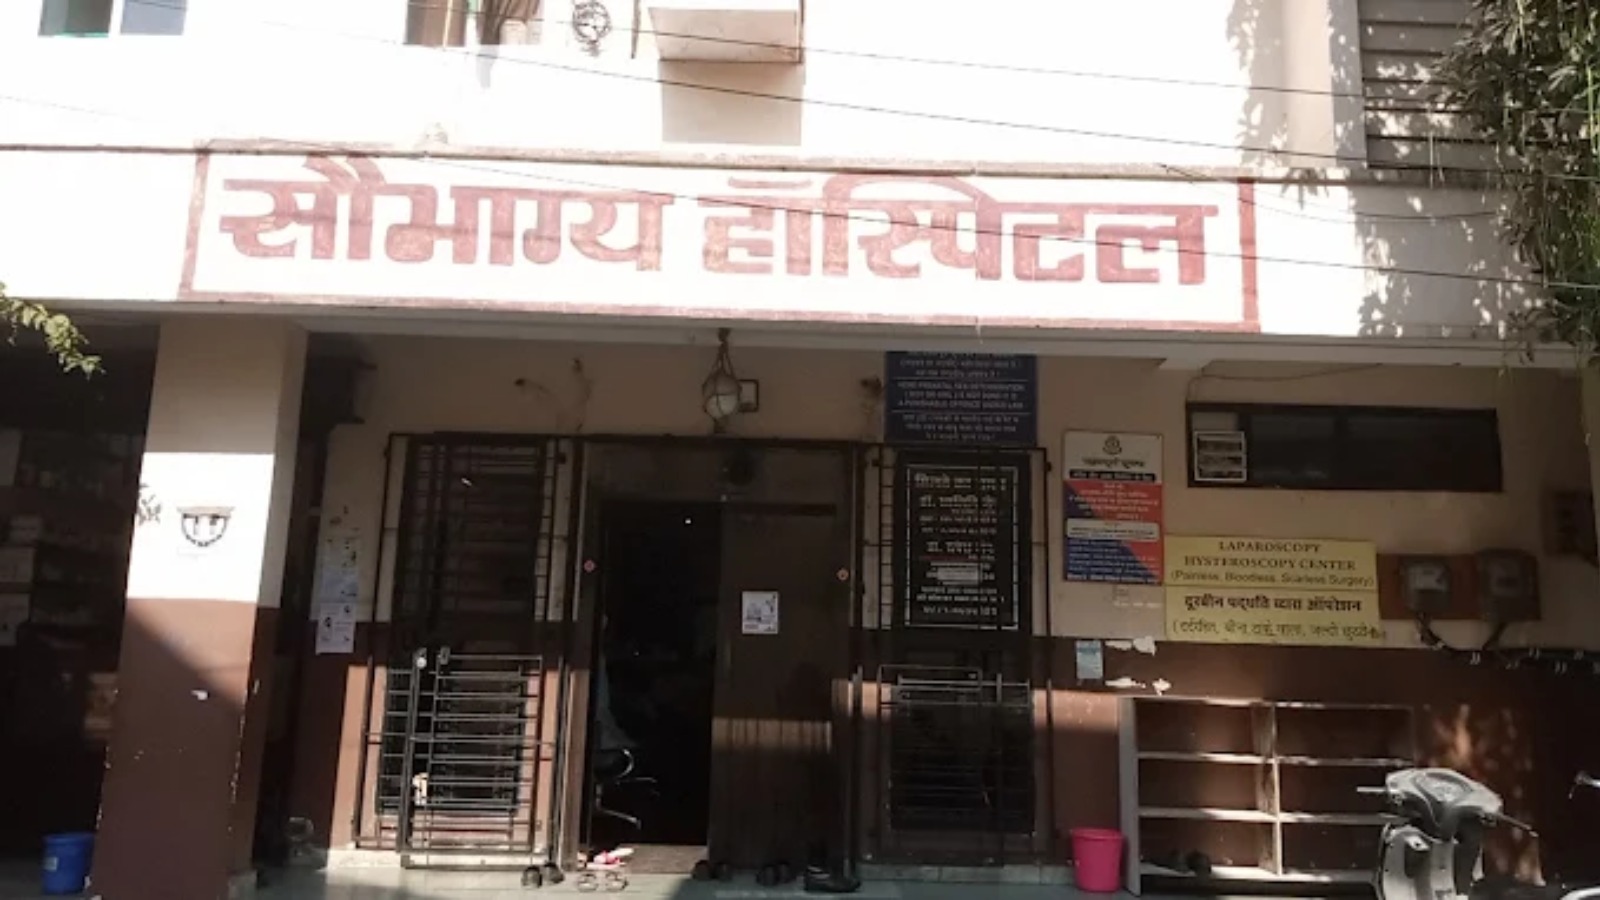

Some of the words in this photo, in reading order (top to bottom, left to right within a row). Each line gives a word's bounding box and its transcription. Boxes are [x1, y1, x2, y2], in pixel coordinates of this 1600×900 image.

[219, 153, 675, 272] सौभाग्य
[699, 174, 1218, 285] हॉस्पिटल
[1218, 541, 1322, 553] LAPAROSCOPY
[1184, 555, 1295, 569] HYSTEROSCOPY
[1298, 559, 1357, 571] CENTER
